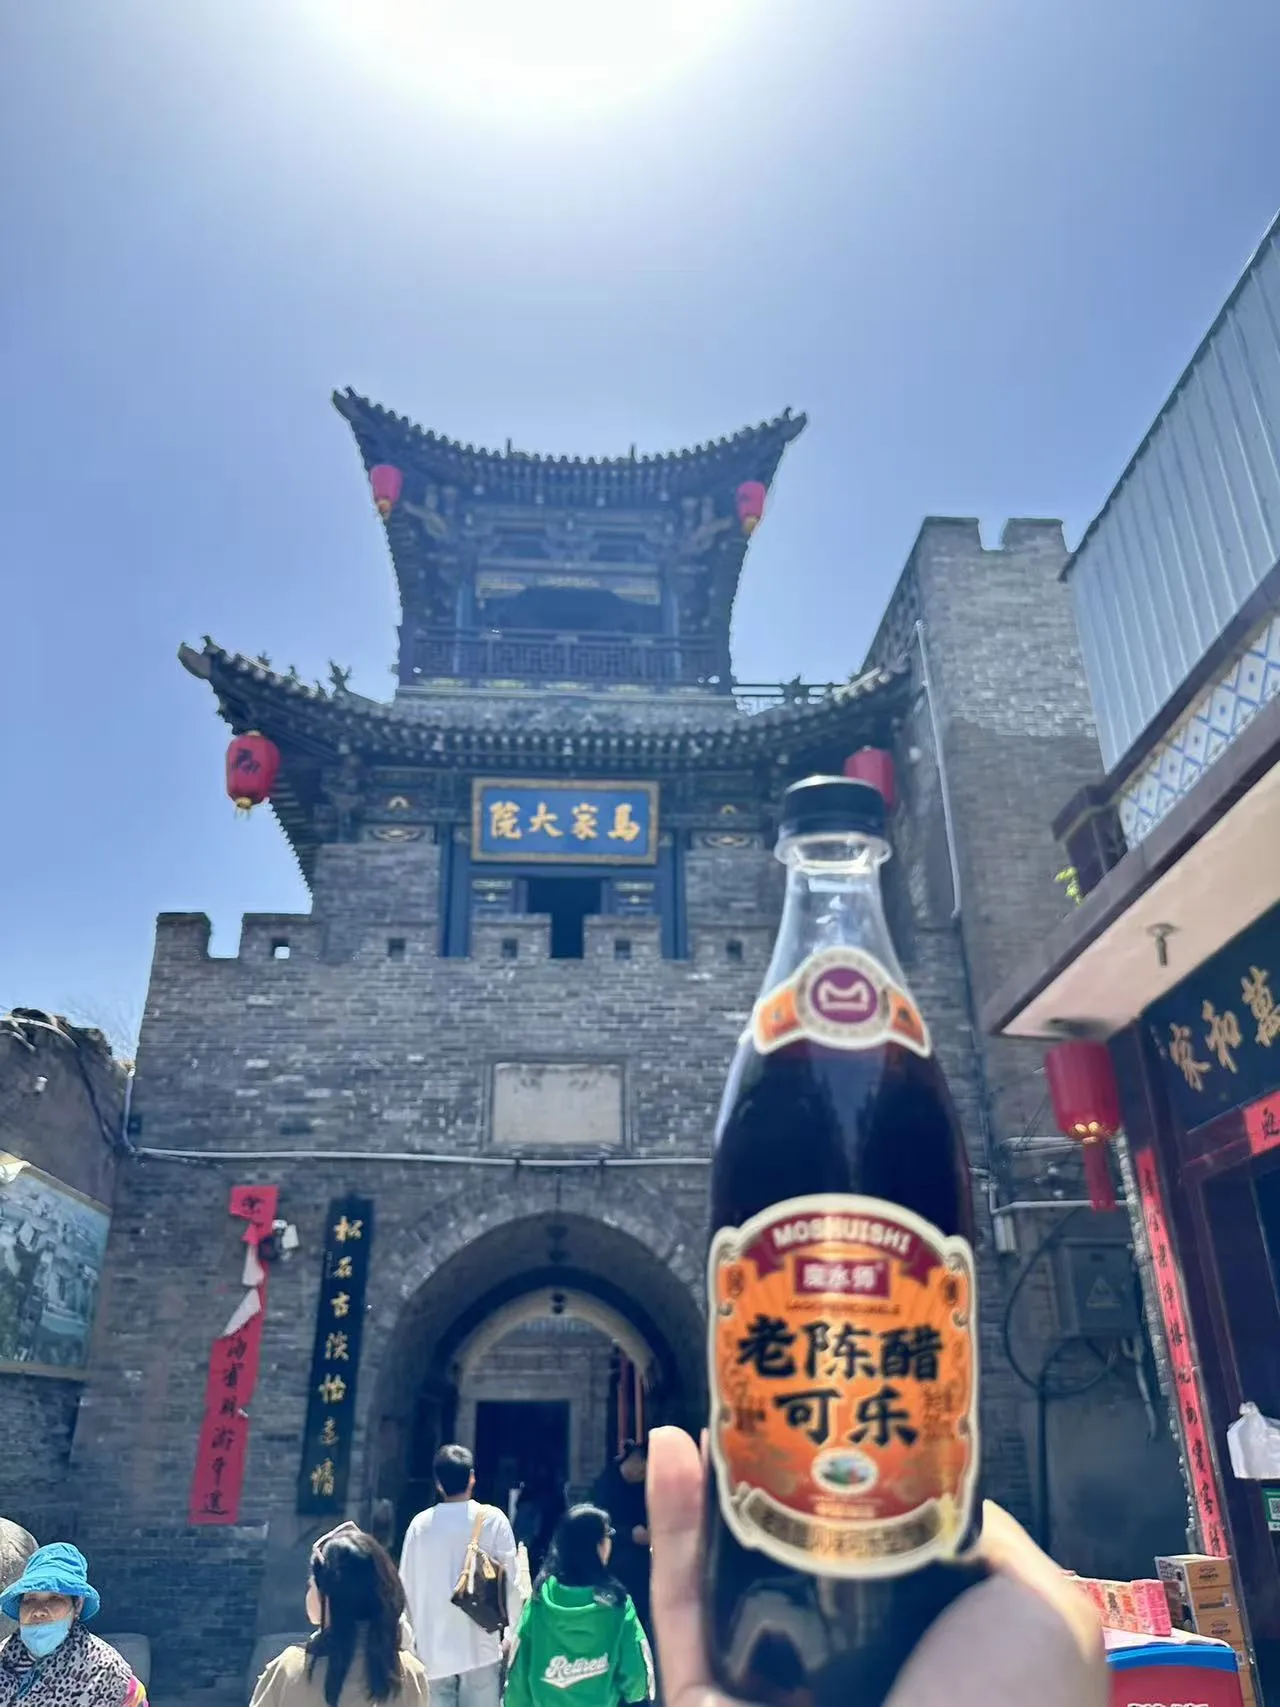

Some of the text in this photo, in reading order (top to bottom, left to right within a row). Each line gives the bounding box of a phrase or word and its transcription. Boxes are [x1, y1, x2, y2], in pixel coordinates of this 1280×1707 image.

[773, 1216, 912, 1256] MOSHUISHI
[736, 1314, 944, 1381] 老陈醋
[773, 1386, 919, 1447] 可乐
